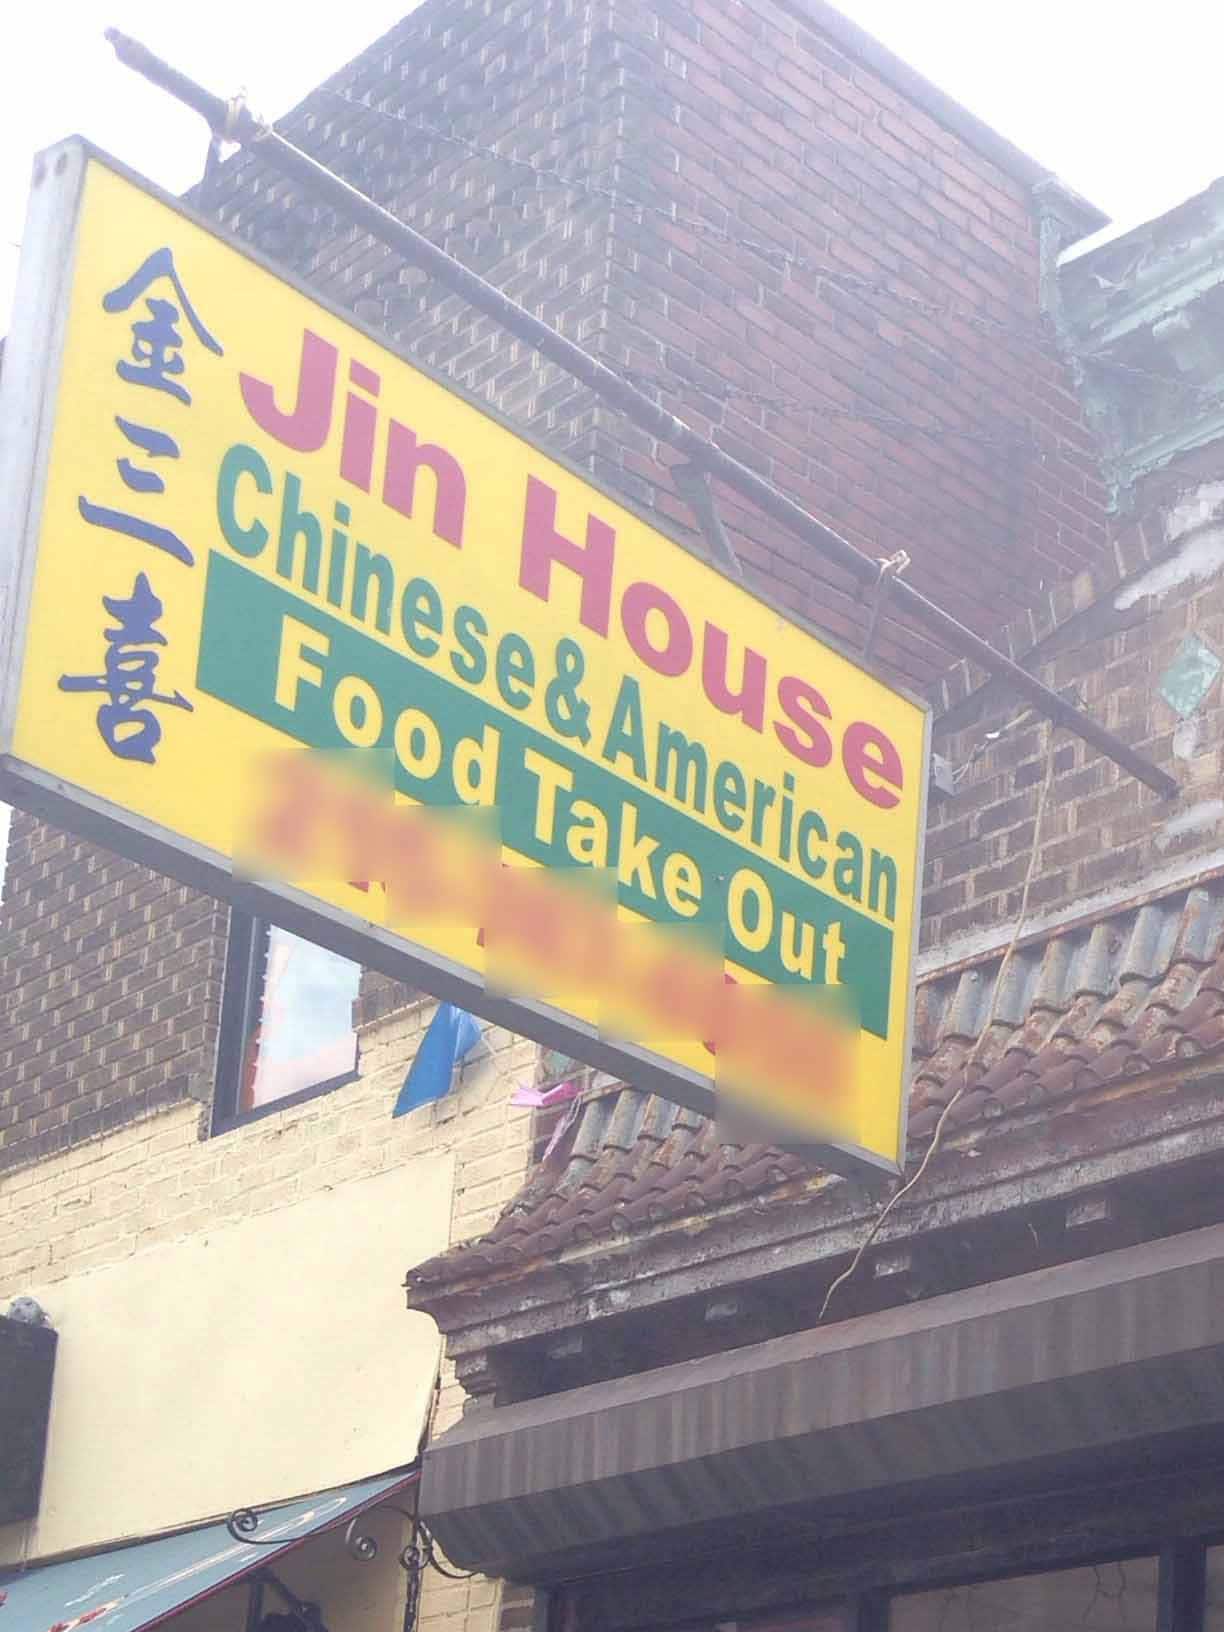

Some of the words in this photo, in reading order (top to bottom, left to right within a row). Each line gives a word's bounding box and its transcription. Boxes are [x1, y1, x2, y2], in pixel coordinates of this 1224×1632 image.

[57, 247, 224, 765] 金三喜
[239, 328, 467, 550] Jin
[518, 473, 904, 810] House
[274, 613, 501, 807] Food
[524, 748, 701, 918] Take
[727, 867, 846, 986] Out
